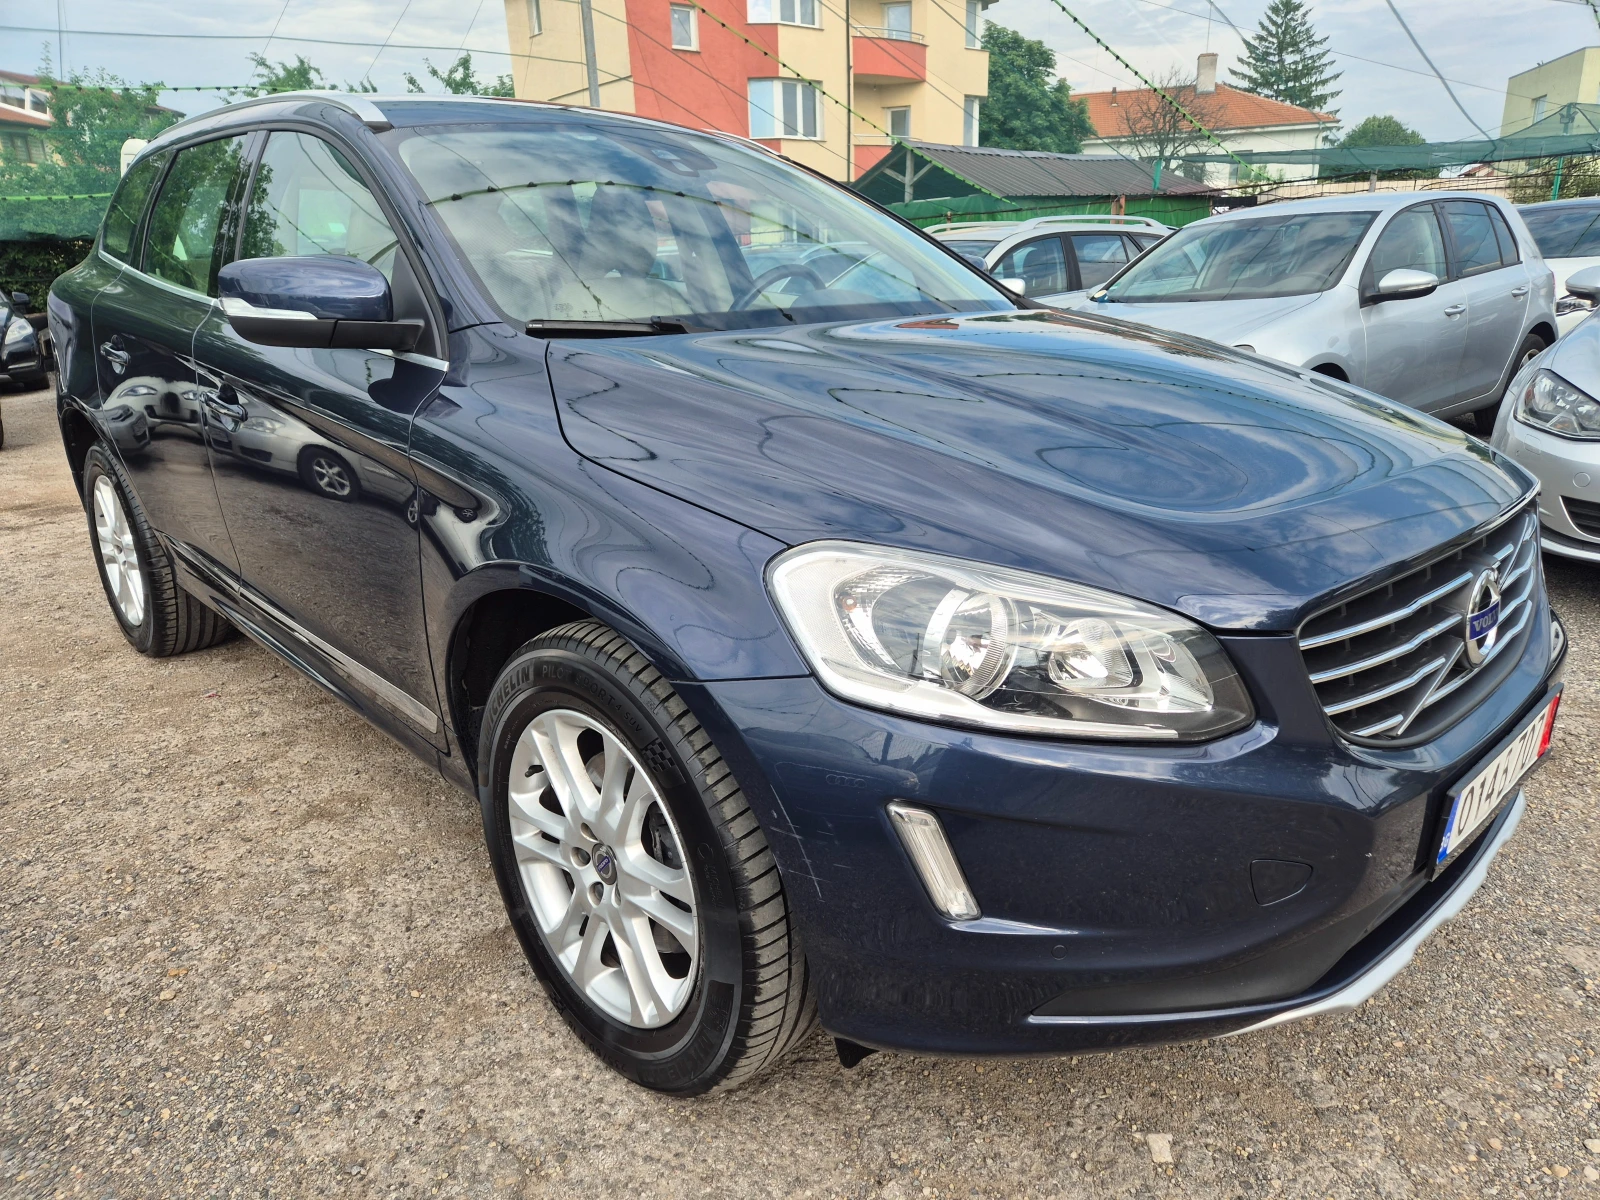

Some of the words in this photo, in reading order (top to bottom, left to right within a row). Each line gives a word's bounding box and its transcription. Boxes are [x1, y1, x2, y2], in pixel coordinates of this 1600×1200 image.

[542, 665, 572, 682] PILOT
[574, 672, 616, 706] SPORT
[624, 711, 644, 733] SUV
